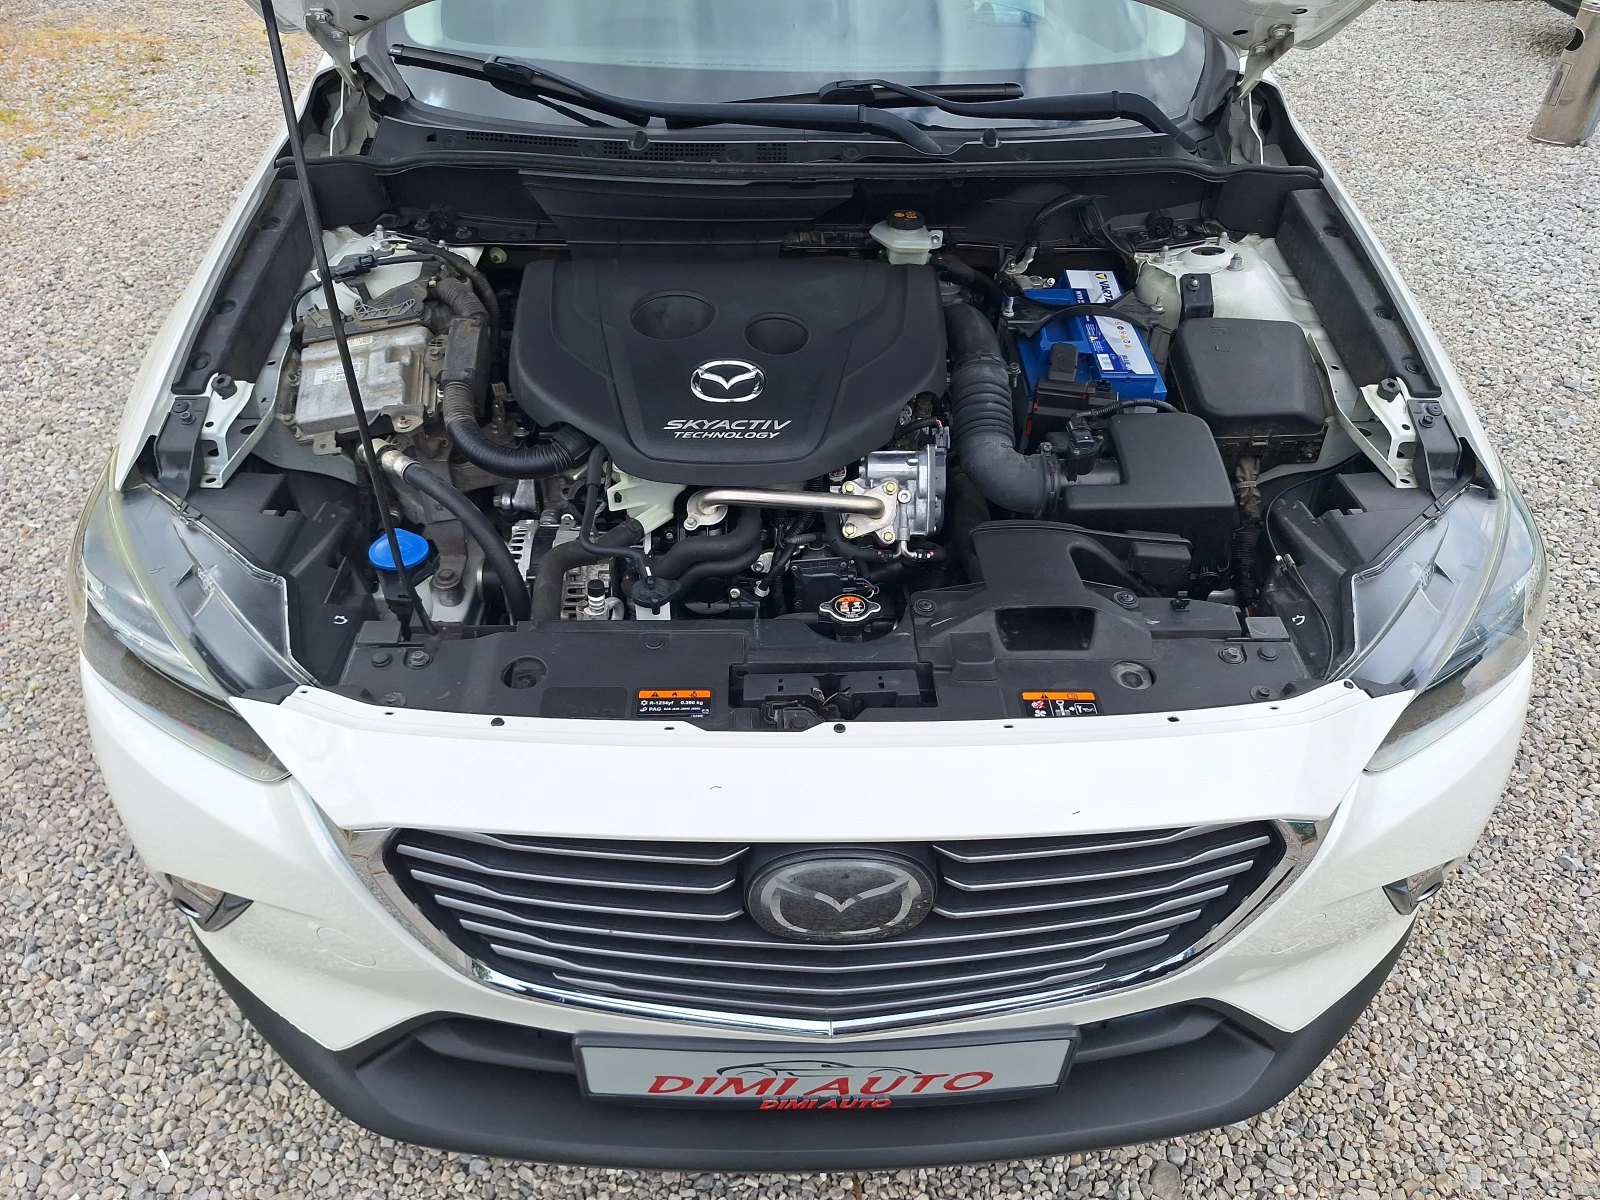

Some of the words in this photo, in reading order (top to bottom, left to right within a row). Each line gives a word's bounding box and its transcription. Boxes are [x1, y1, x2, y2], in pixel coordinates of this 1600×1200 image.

[663, 419, 792, 430] SKYACTIV
[673, 431, 781, 439] TECHNOLOGY
[647, 1075, 800, 1095] DIMI
[802, 1071, 994, 1096] AUTO
[759, 1096, 819, 1110] DIMI
[818, 1095, 892, 1109] AUTO
